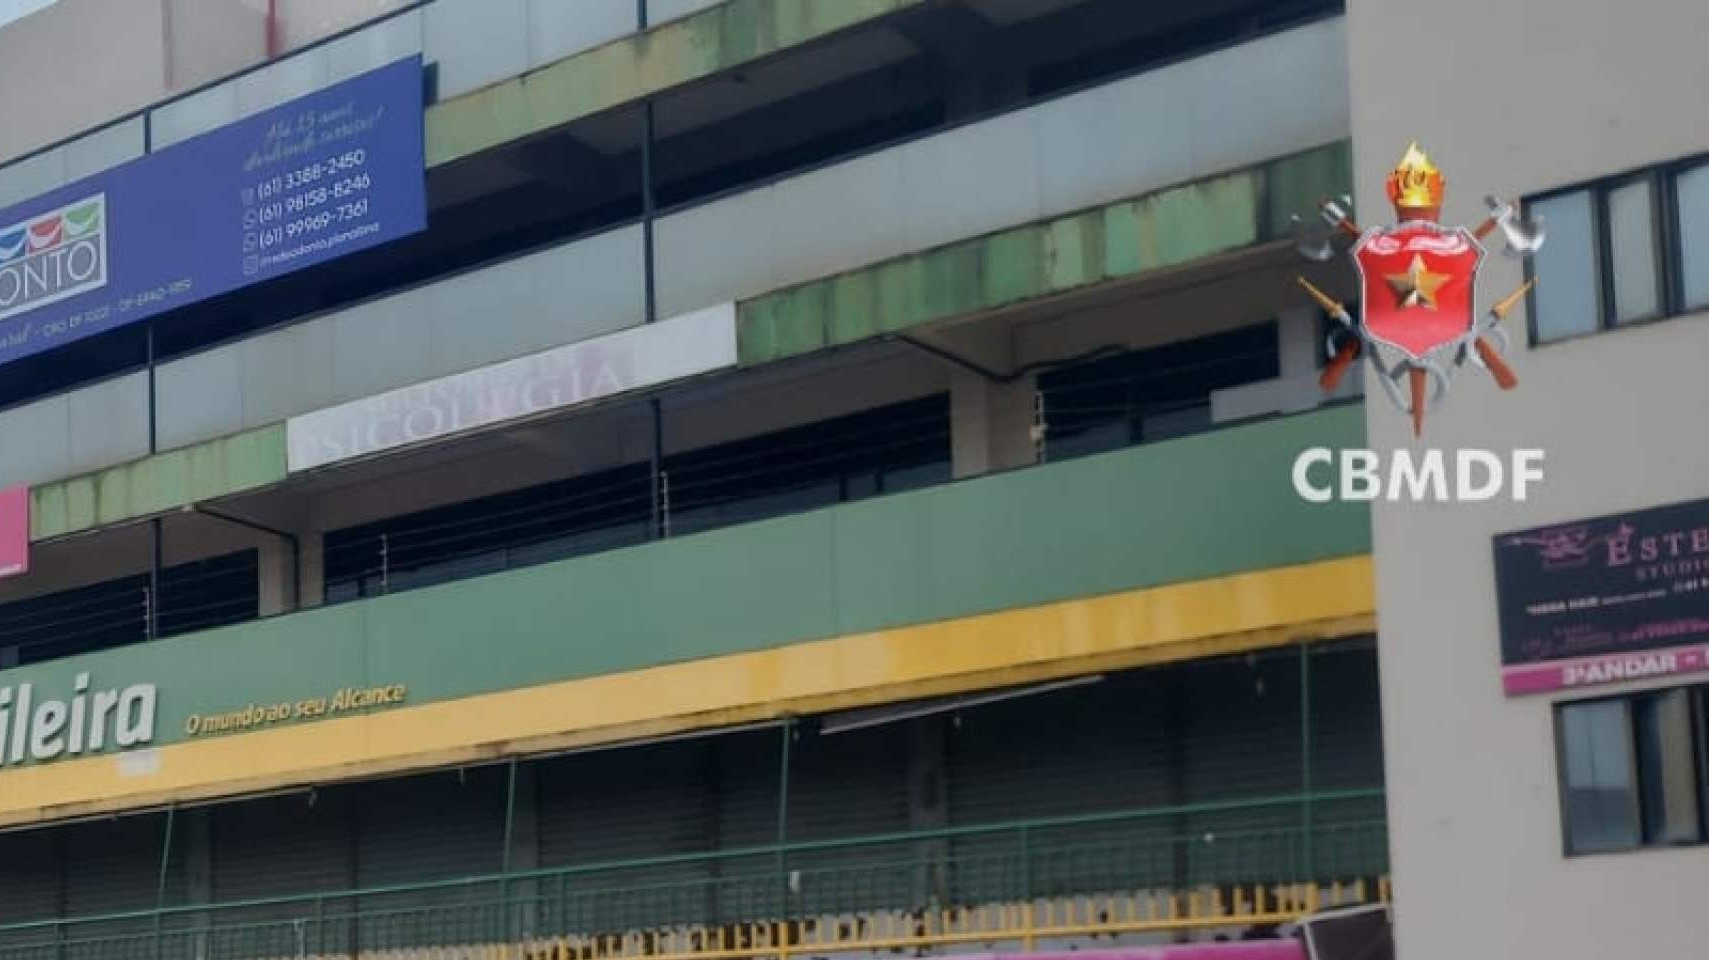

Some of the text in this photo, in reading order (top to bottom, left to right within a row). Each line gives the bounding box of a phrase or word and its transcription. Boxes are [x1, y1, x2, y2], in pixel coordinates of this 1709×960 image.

[258, 148, 366, 200] (61) 3388-2450
[259, 201, 282, 225] (61)
[259, 226, 282, 249] (61)
[295, 698, 327, 717] seu
[331, 683, 407, 711] Alcance
